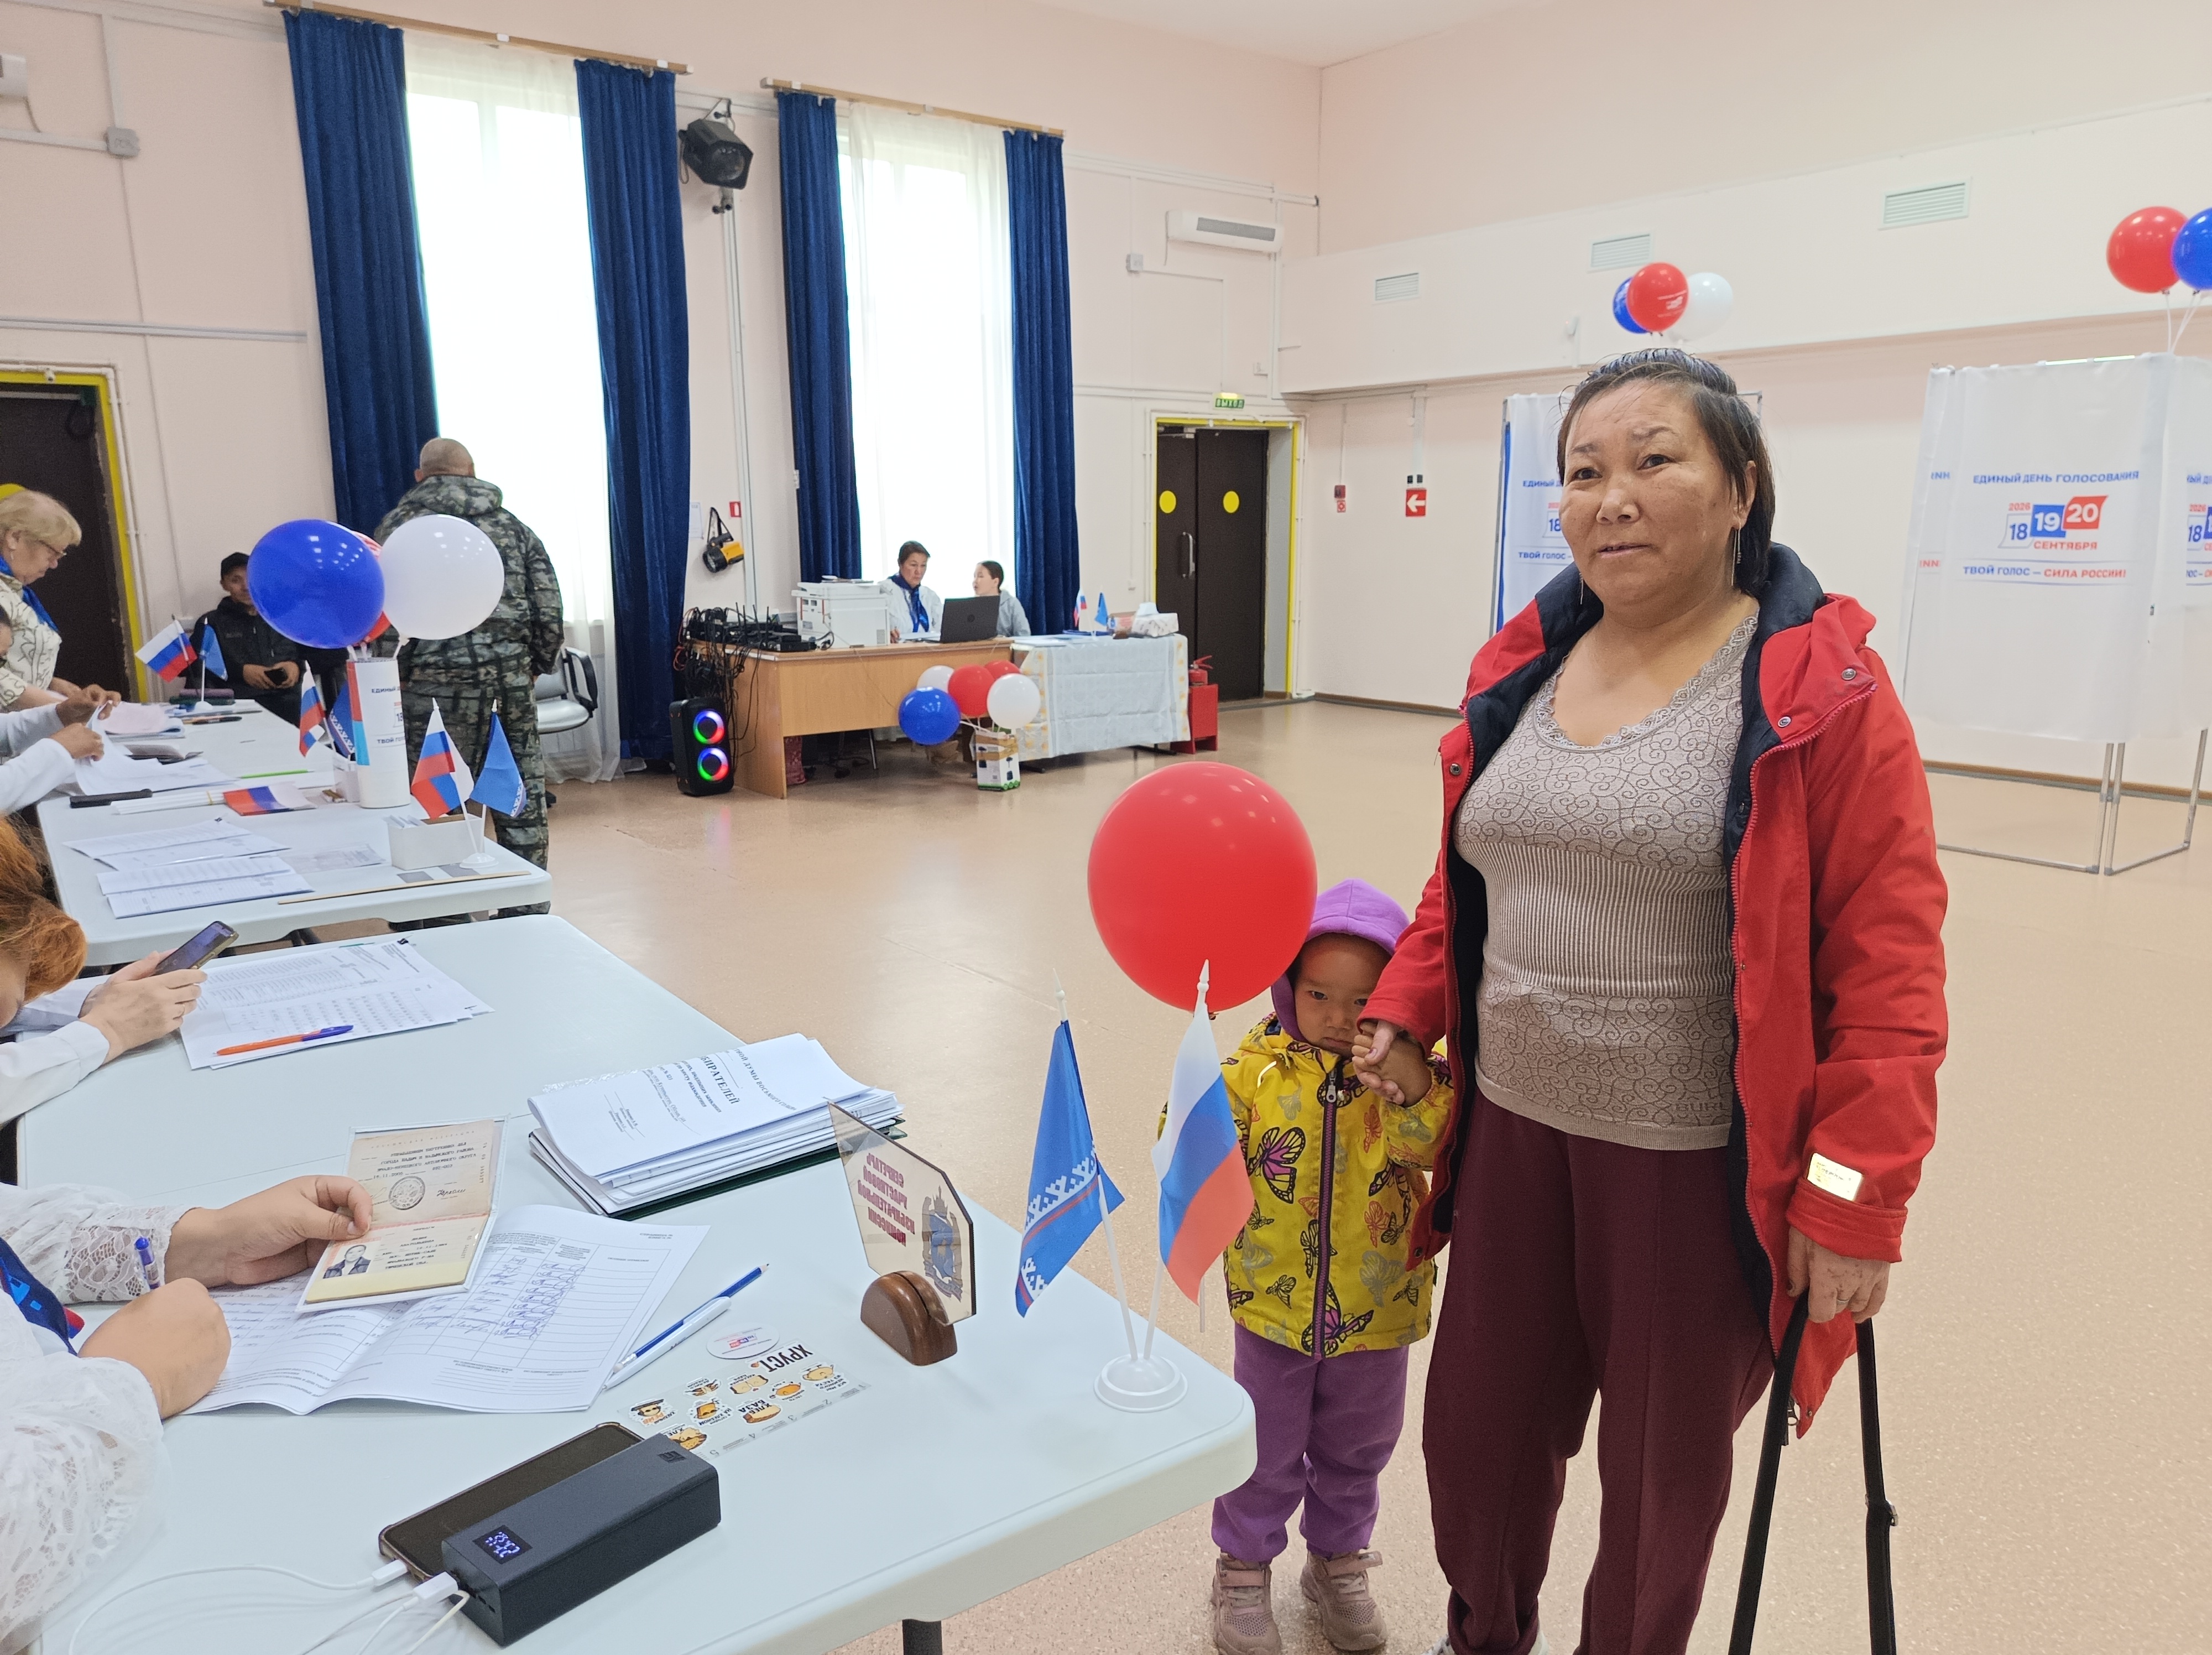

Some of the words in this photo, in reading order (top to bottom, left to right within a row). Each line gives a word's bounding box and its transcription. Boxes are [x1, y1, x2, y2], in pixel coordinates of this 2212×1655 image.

[1523, 479, 1554, 487] ЕДИНЫЙ
[1973, 472, 2021, 484] ЕДИНЫЙ
[2023, 473, 2052, 483] ДЕНЬ
[2056, 470, 2139, 483] ГОЛОСОВАНИЯ
[2008, 502, 2031, 511] 2026
[2010, 523, 2028, 540] 18
[2034, 512, 2060, 532] 19
[2067, 503, 2099, 523] 20
[2188, 525, 2203, 542] 18
[2034, 540, 2098, 550] СЕНТЯБРЯ
[1963, 565, 1994, 575] ТВОЙ
[1997, 566, 2030, 575] ГОЛОС
[2044, 569, 2078, 577] СИЛА
[2081, 569, 2126, 578] РОССИИ!
[759, 1344, 813, 1372] ХРУСТ
[738, 1399, 766, 1412] БАЗА
[749, 1403, 772, 1414] ХЛЕБ
